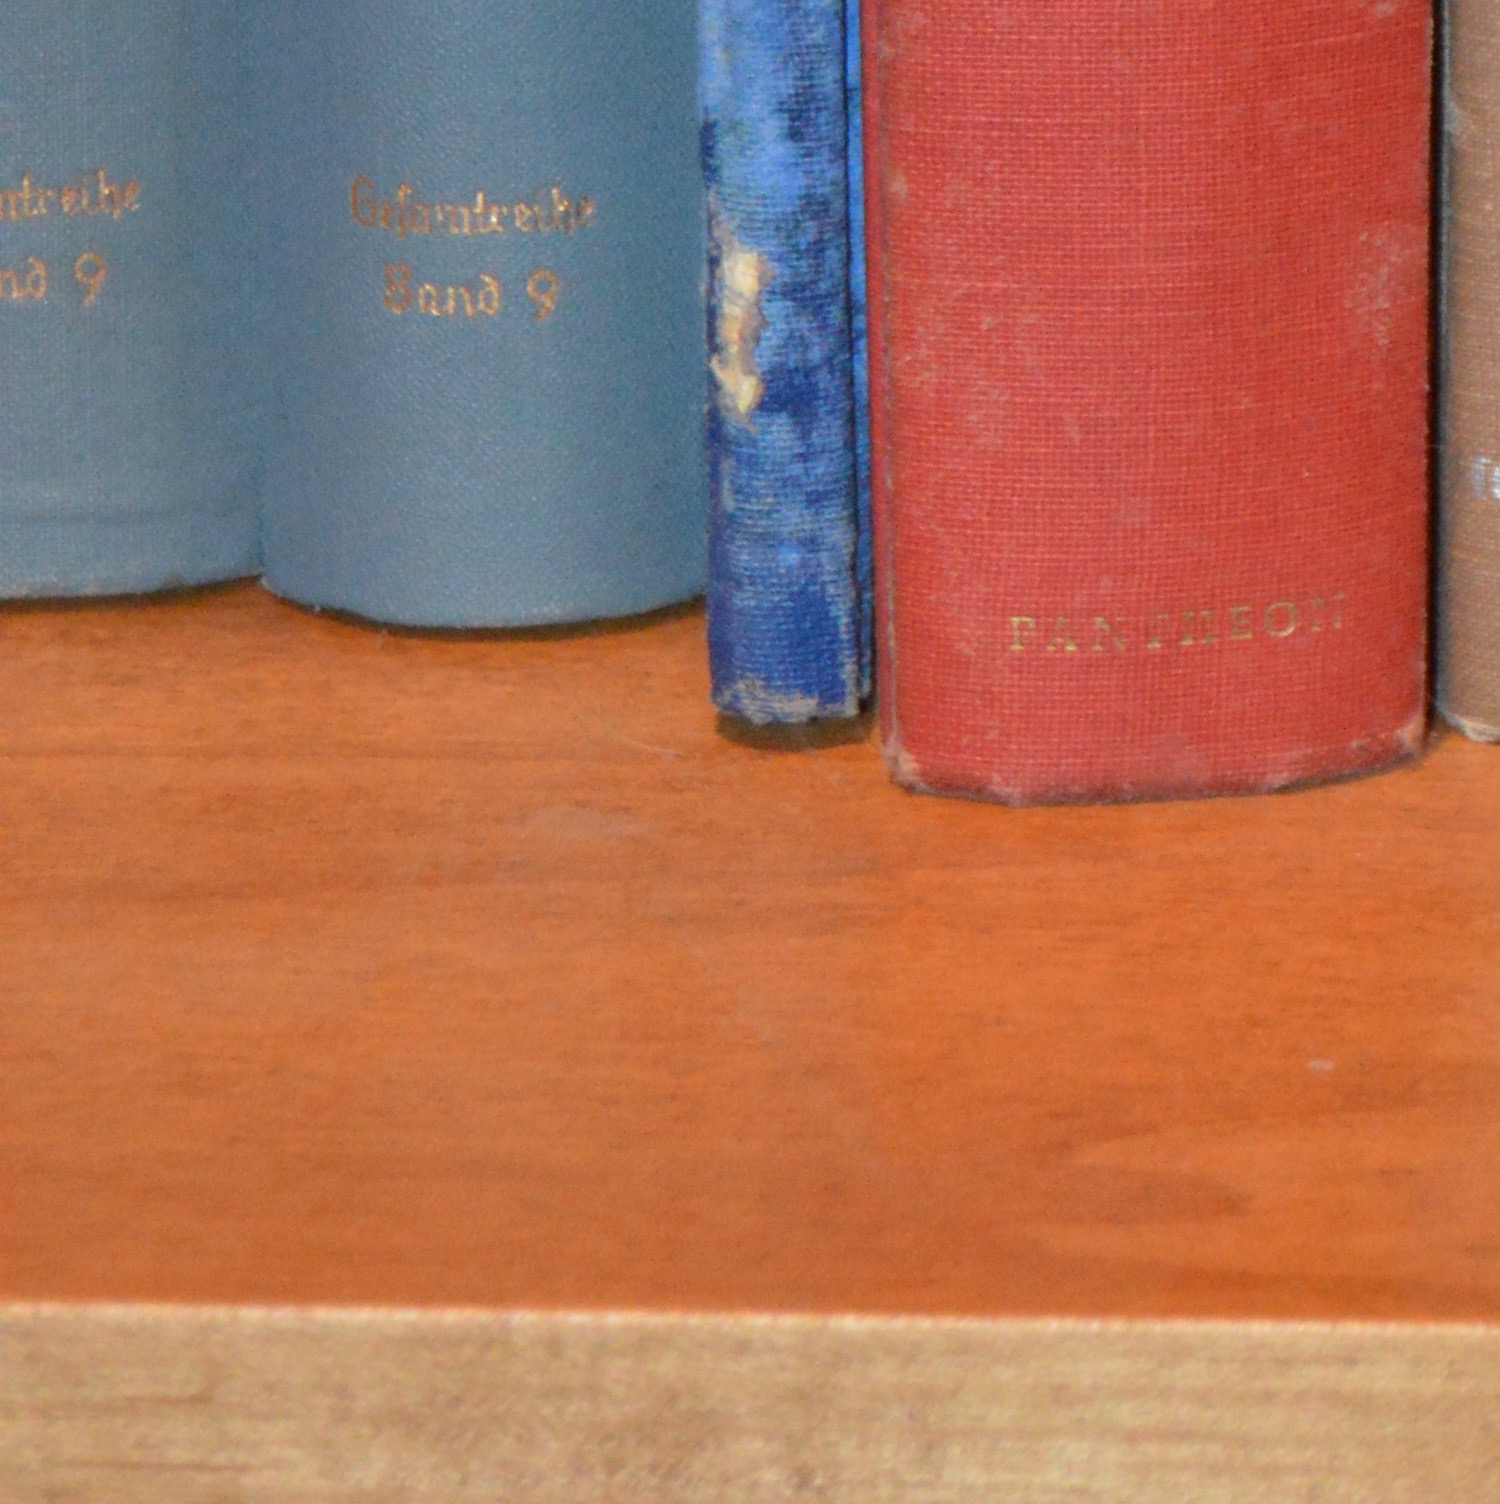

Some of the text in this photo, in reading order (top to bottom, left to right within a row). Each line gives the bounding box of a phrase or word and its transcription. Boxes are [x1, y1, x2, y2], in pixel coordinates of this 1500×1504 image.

[73, 251, 107, 307] 9
[383, 263, 560, 324] Band 9
